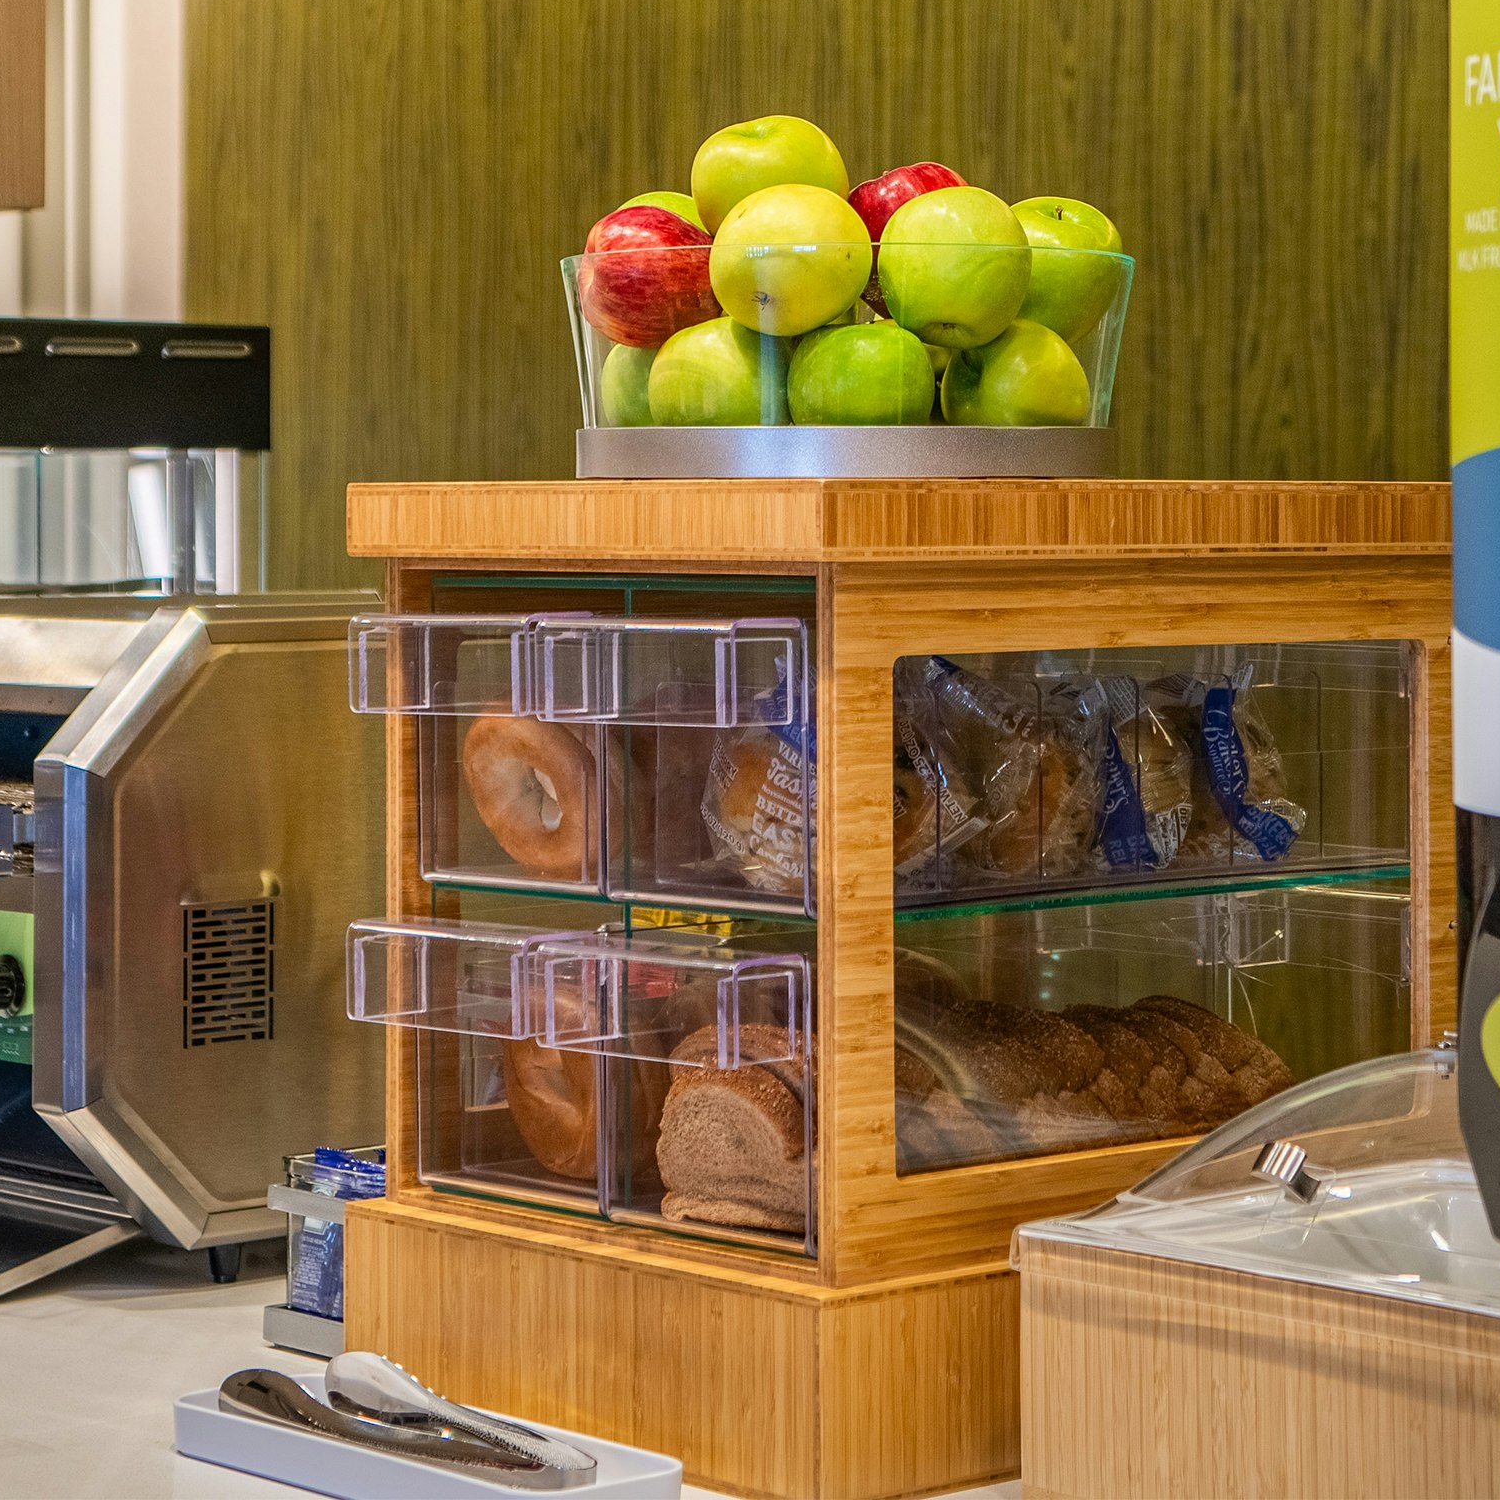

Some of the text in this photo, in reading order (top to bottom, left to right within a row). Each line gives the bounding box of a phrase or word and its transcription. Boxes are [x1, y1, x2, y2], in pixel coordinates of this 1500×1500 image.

[1464, 207, 1498, 234] MADE
[904, 739, 921, 759] OZ
[946, 799, 968, 825] NET
